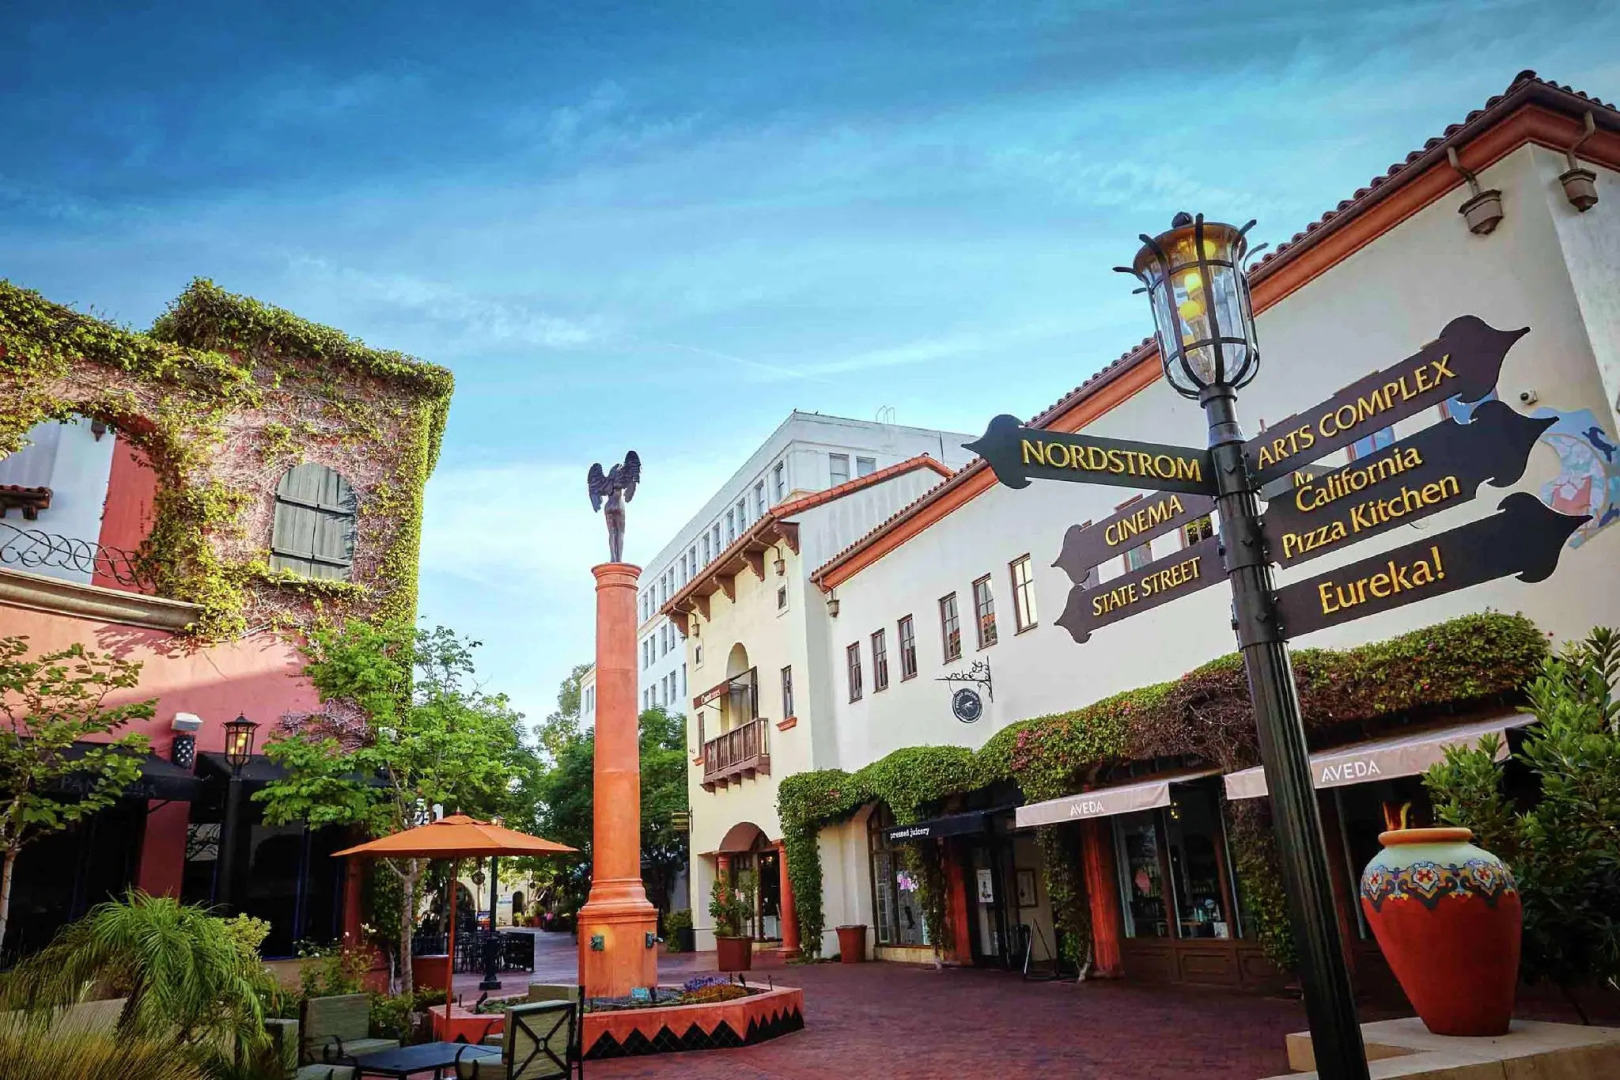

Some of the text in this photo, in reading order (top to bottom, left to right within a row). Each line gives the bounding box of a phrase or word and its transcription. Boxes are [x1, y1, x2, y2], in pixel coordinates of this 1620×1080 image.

[1258, 354, 1456, 470] ARTS COMPLEX
[1021, 439, 1202, 482] NORDSTROM
[1296, 447, 1423, 512] California
[1105, 494, 1184, 546] CINEMA
[1282, 475, 1461, 559] Pizza Kitchen
[1092, 556, 1201, 616] STATE STREET
[1318, 546, 1445, 614] Eureka!
[1322, 760, 1381, 783] AVEDA
[1070, 800, 1104, 817] AVEDA
